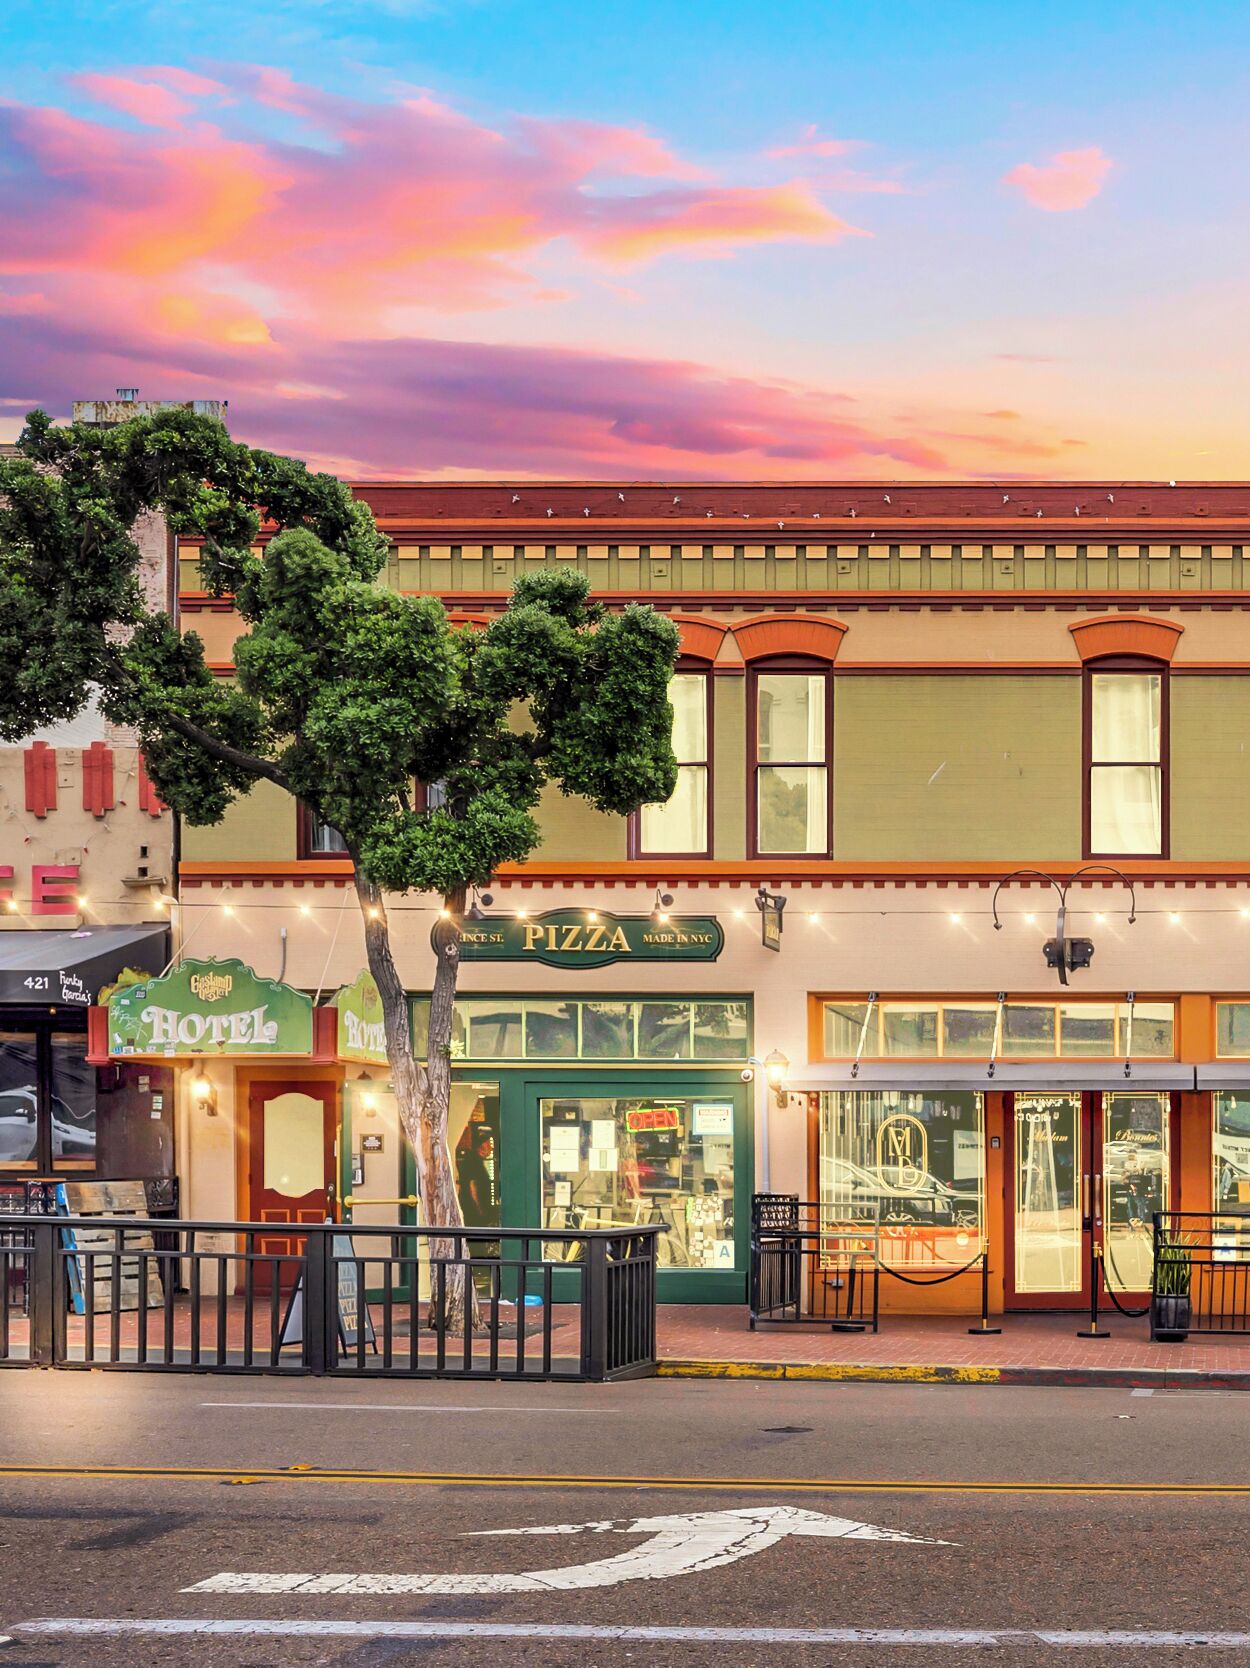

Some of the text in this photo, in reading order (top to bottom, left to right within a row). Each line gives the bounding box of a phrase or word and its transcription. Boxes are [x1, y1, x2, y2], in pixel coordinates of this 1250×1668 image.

[489, 933, 504, 943] ST.
[522, 924, 632, 953] PIZZA
[643, 933, 713, 943] MADE IN NYC
[24, 976, 49, 989] 421
[141, 1004, 278, 1045] HOTEL
[344, 1010, 387, 1054] HOTE
[628, 1104, 677, 1129] OPEN
[719, 1245, 731, 1258] A
